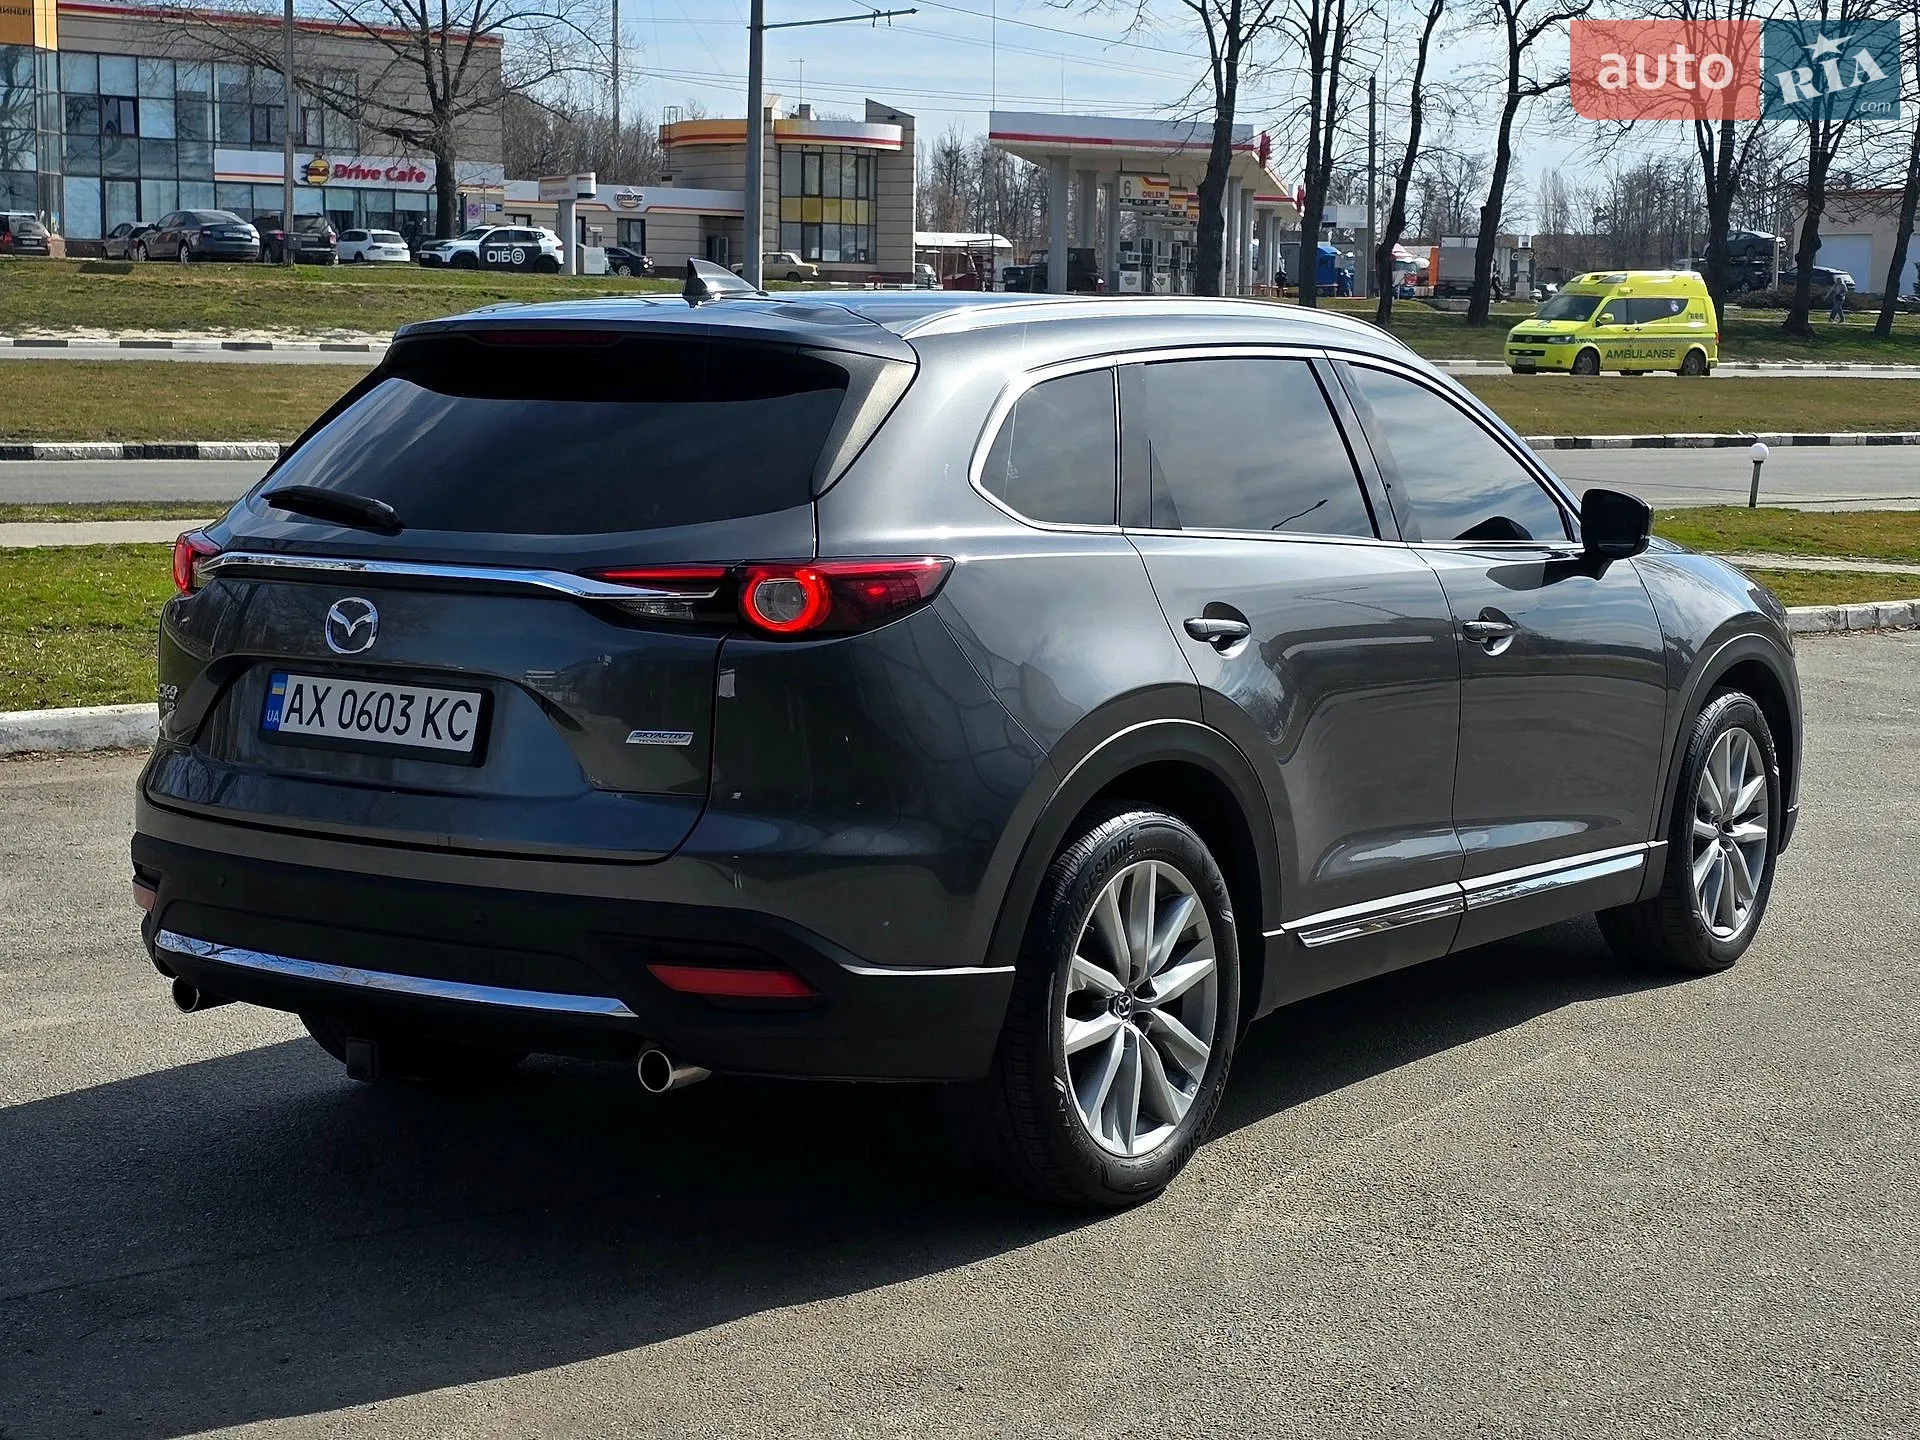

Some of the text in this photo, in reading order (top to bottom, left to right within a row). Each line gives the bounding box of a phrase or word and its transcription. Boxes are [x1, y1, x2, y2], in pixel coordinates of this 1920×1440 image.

[334, 164, 426, 183] Drive Cafe
[1123, 180, 1132, 198] 6
[1141, 191, 1165, 199] ORLEN
[1605, 349, 1676, 360] AMBULANSE
[266, 709, 280, 723] UA
[284, 683, 473, 742] AX 0603 KC
